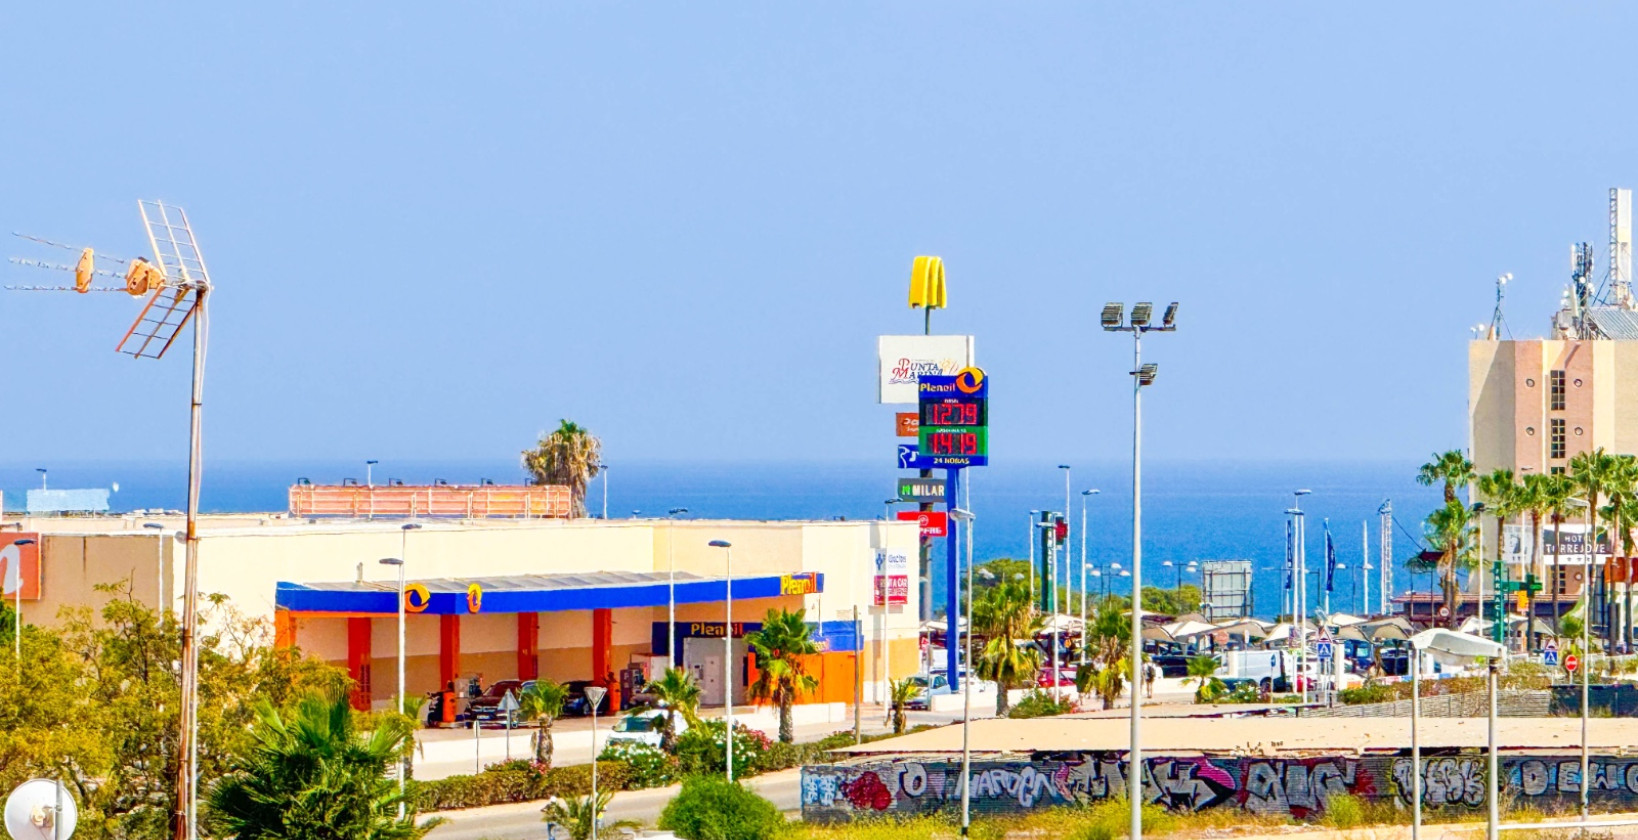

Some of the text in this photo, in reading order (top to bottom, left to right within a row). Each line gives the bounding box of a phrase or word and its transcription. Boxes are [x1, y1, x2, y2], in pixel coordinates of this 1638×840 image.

[898, 358, 939, 371] PUNTA
[920, 382, 955, 392] Plenoil
[912, 484, 945, 497] MILAR
[1564, 535, 1592, 543] HOTL
[691, 622, 743, 636] Plenil
